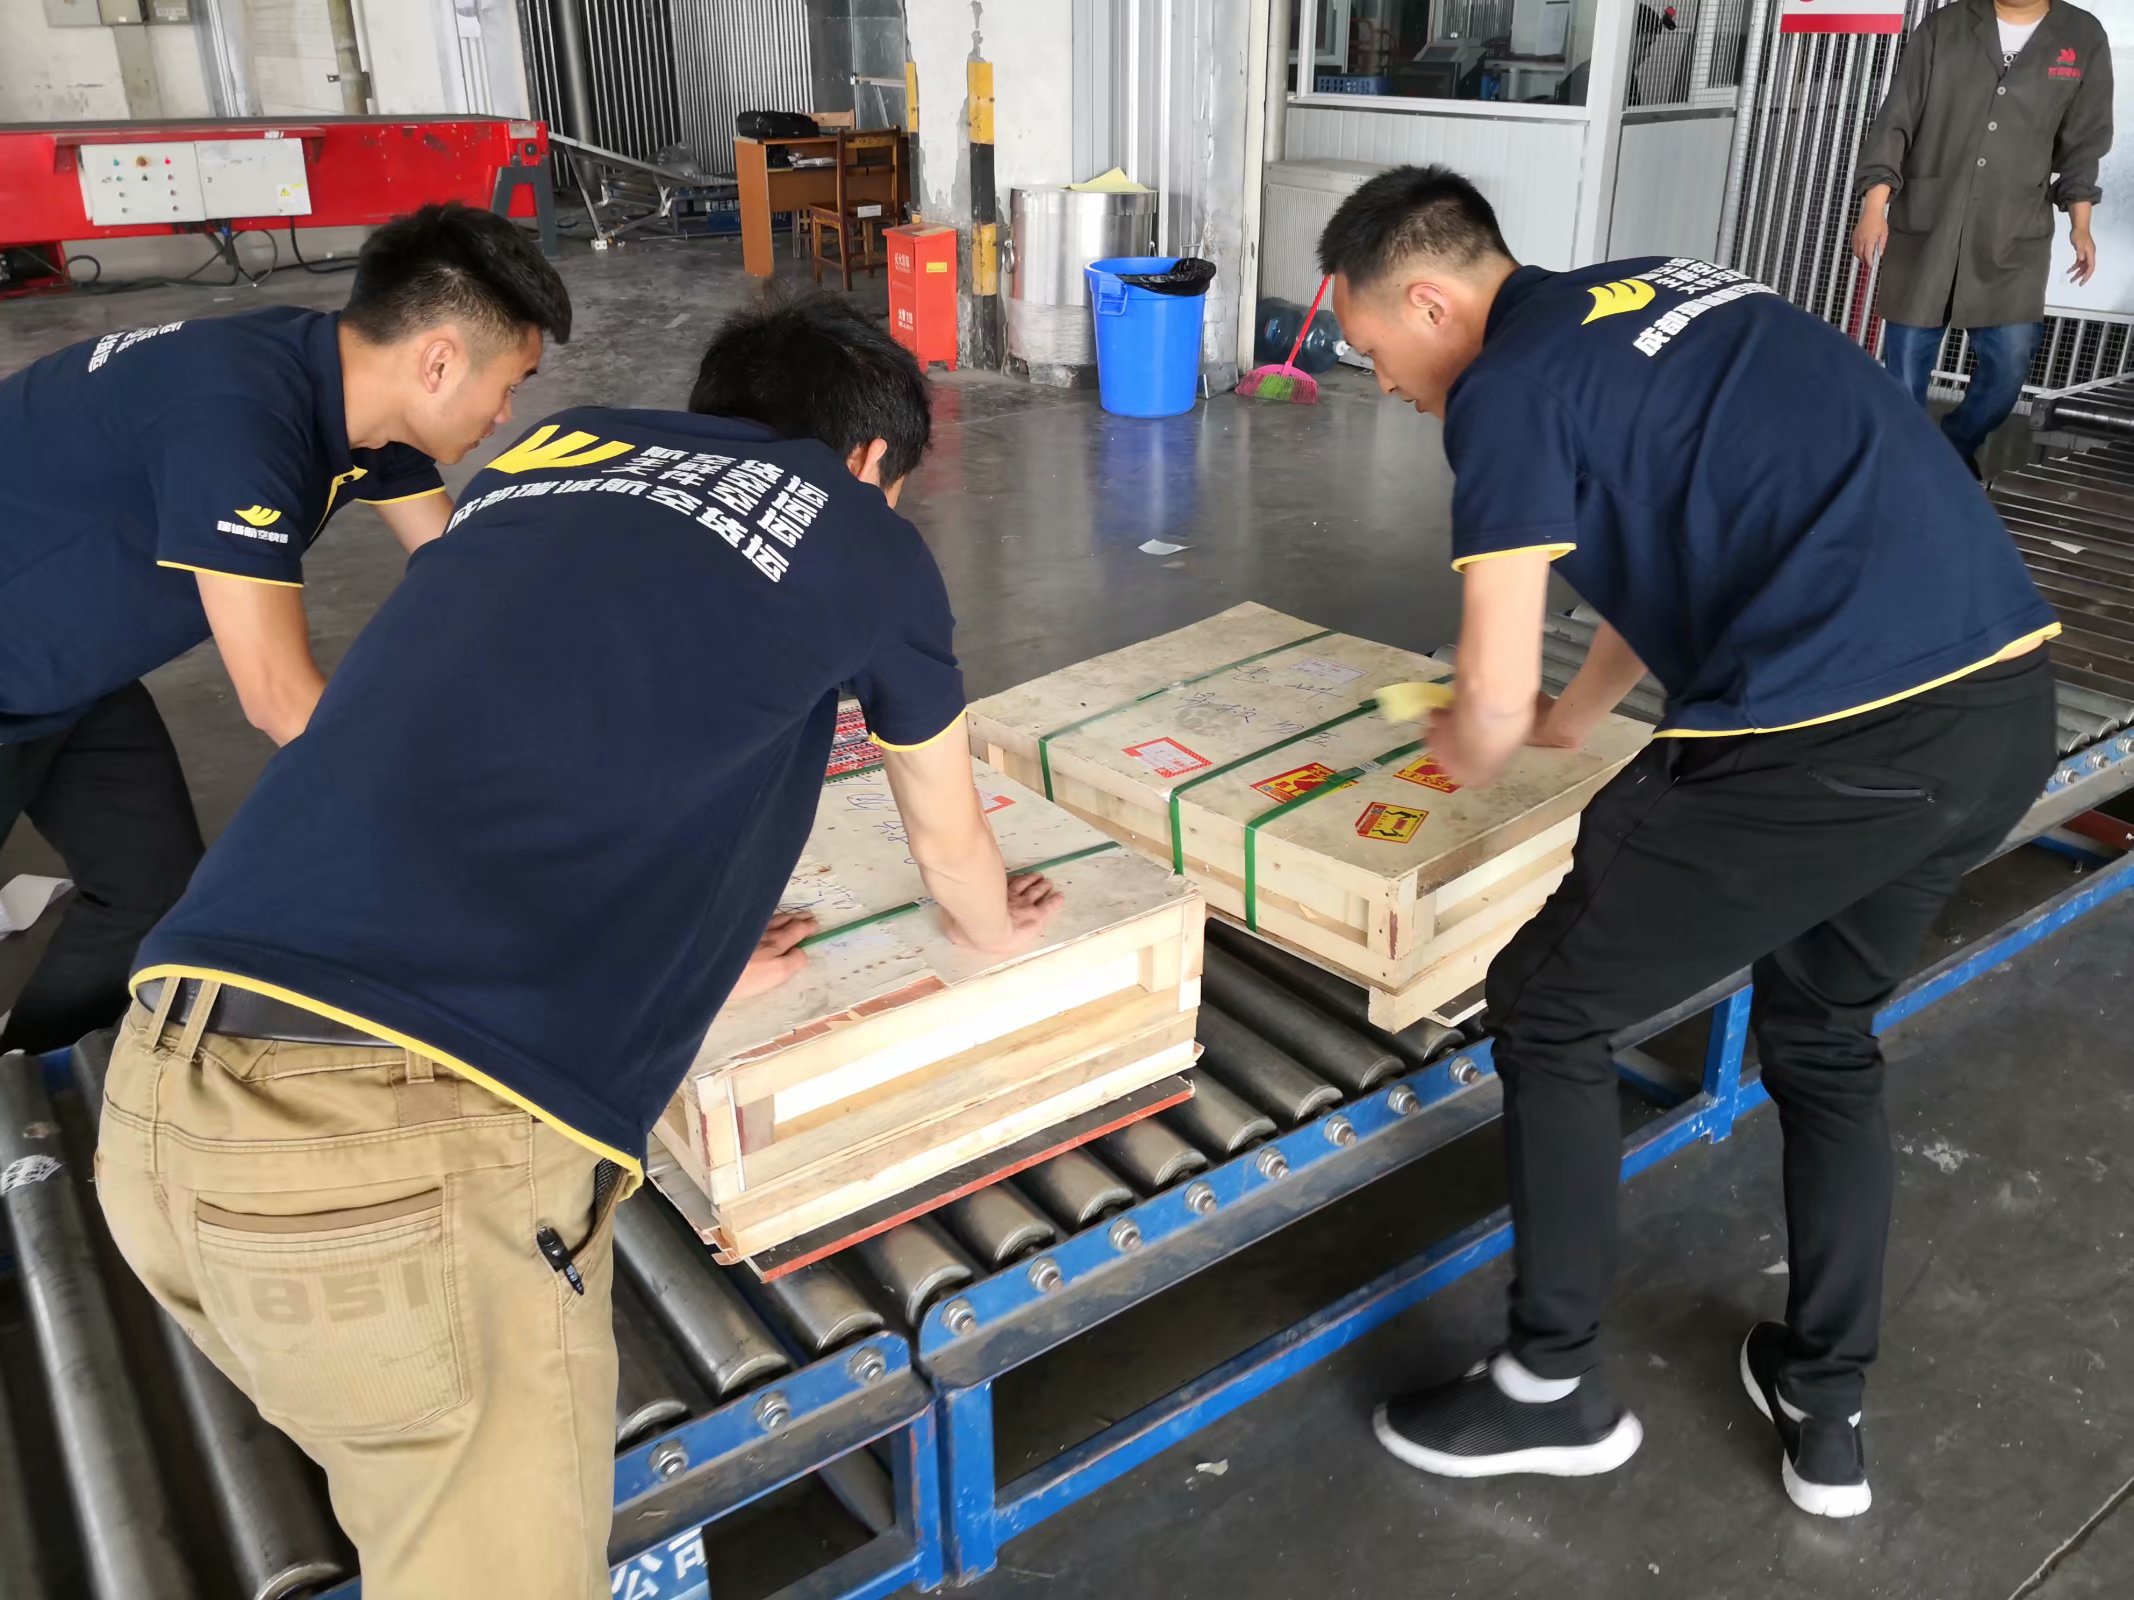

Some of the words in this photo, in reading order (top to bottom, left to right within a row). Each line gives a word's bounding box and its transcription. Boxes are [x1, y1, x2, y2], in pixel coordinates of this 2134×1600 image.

[602, 466, 805, 548] 大件空运
[625, 457, 818, 527] 生鲜空运
[640, 445, 829, 509] 航空货运
[446, 477, 790, 583] 成都瑞诚航空货运
